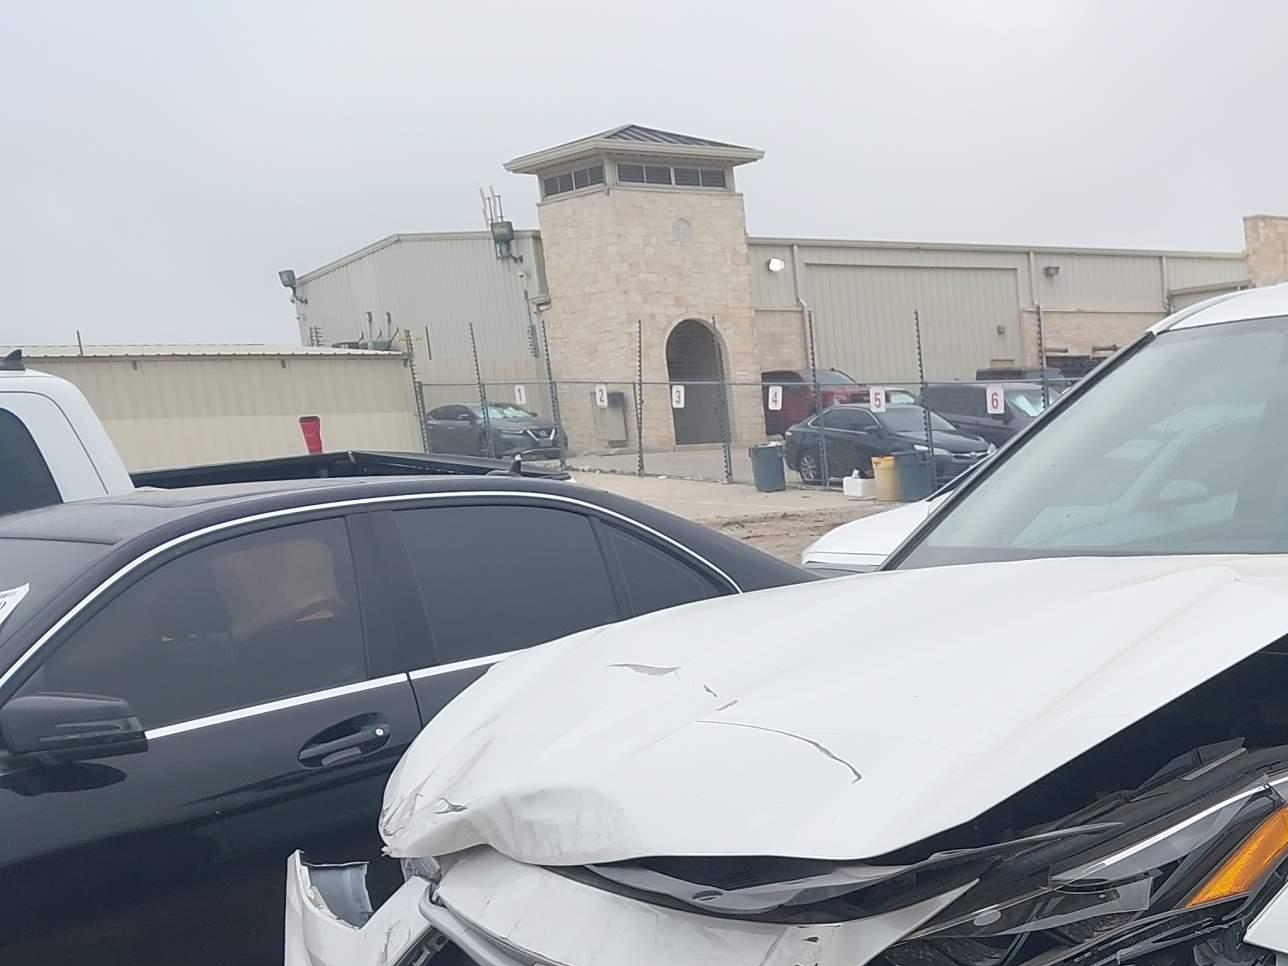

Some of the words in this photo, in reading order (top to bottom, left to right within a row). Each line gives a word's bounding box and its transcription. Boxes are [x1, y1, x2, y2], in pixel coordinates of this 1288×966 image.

[599, 388, 606, 405] 2
[673, 390, 682, 405] 3
[770, 390, 779, 406] 4
[873, 391, 882, 408] 5
[990, 391, 1000, 409] 6
